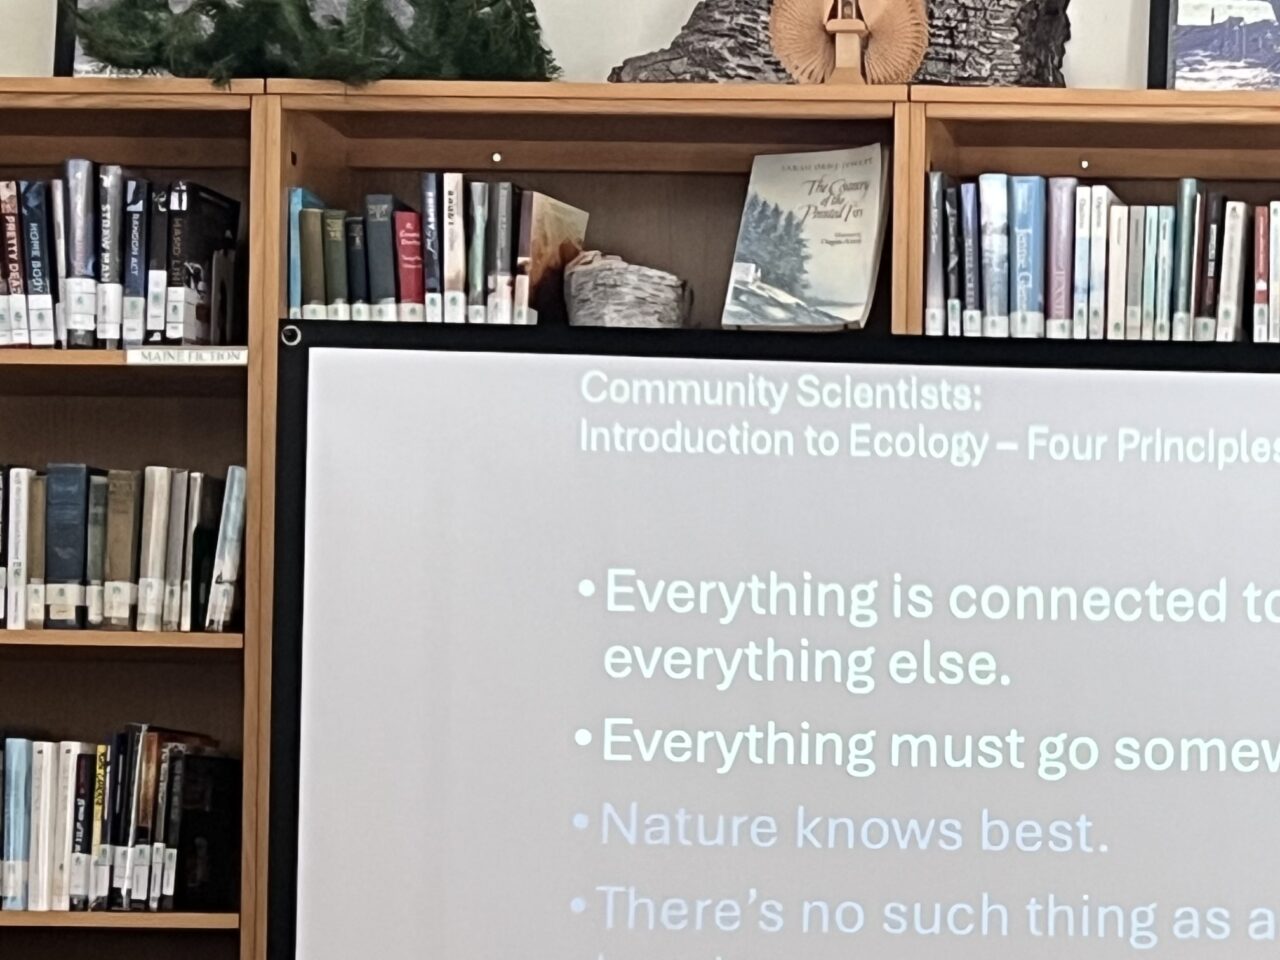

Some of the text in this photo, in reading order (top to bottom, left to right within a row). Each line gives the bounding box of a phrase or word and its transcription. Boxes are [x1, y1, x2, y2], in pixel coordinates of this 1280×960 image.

[4, 212, 18, 261] PRETTY
[29, 222, 43, 294] HOME BODY
[101, 203, 111, 283] STRAW MAN
[130, 213, 140, 276] RANDOM ACT
[140, 350, 242, 362] MAINE FICTION
[580, 369, 983, 414] Community Scientists:
[579, 418, 794, 457] Introduction
[804, 425, 840, 457] to
[850, 423, 989, 468] Ecology
[1027, 425, 1107, 462] Four
[606, 568, 878, 628] Everything
[892, 573, 934, 619] is
[948, 576, 1228, 623] connected
[603, 636, 1011, 694] everything else.
[602, 717, 877, 778] Everything
[890, 728, 1025, 769] must
[1037, 731, 1100, 781] go
[600, 801, 1109, 854] Nature knows best.
[801, 898, 865, 935] no
[882, 891, 1009, 937] such
[1025, 892, 1159, 950] thing
[1171, 905, 1231, 941] as
[1246, 906, 1277, 942] a
